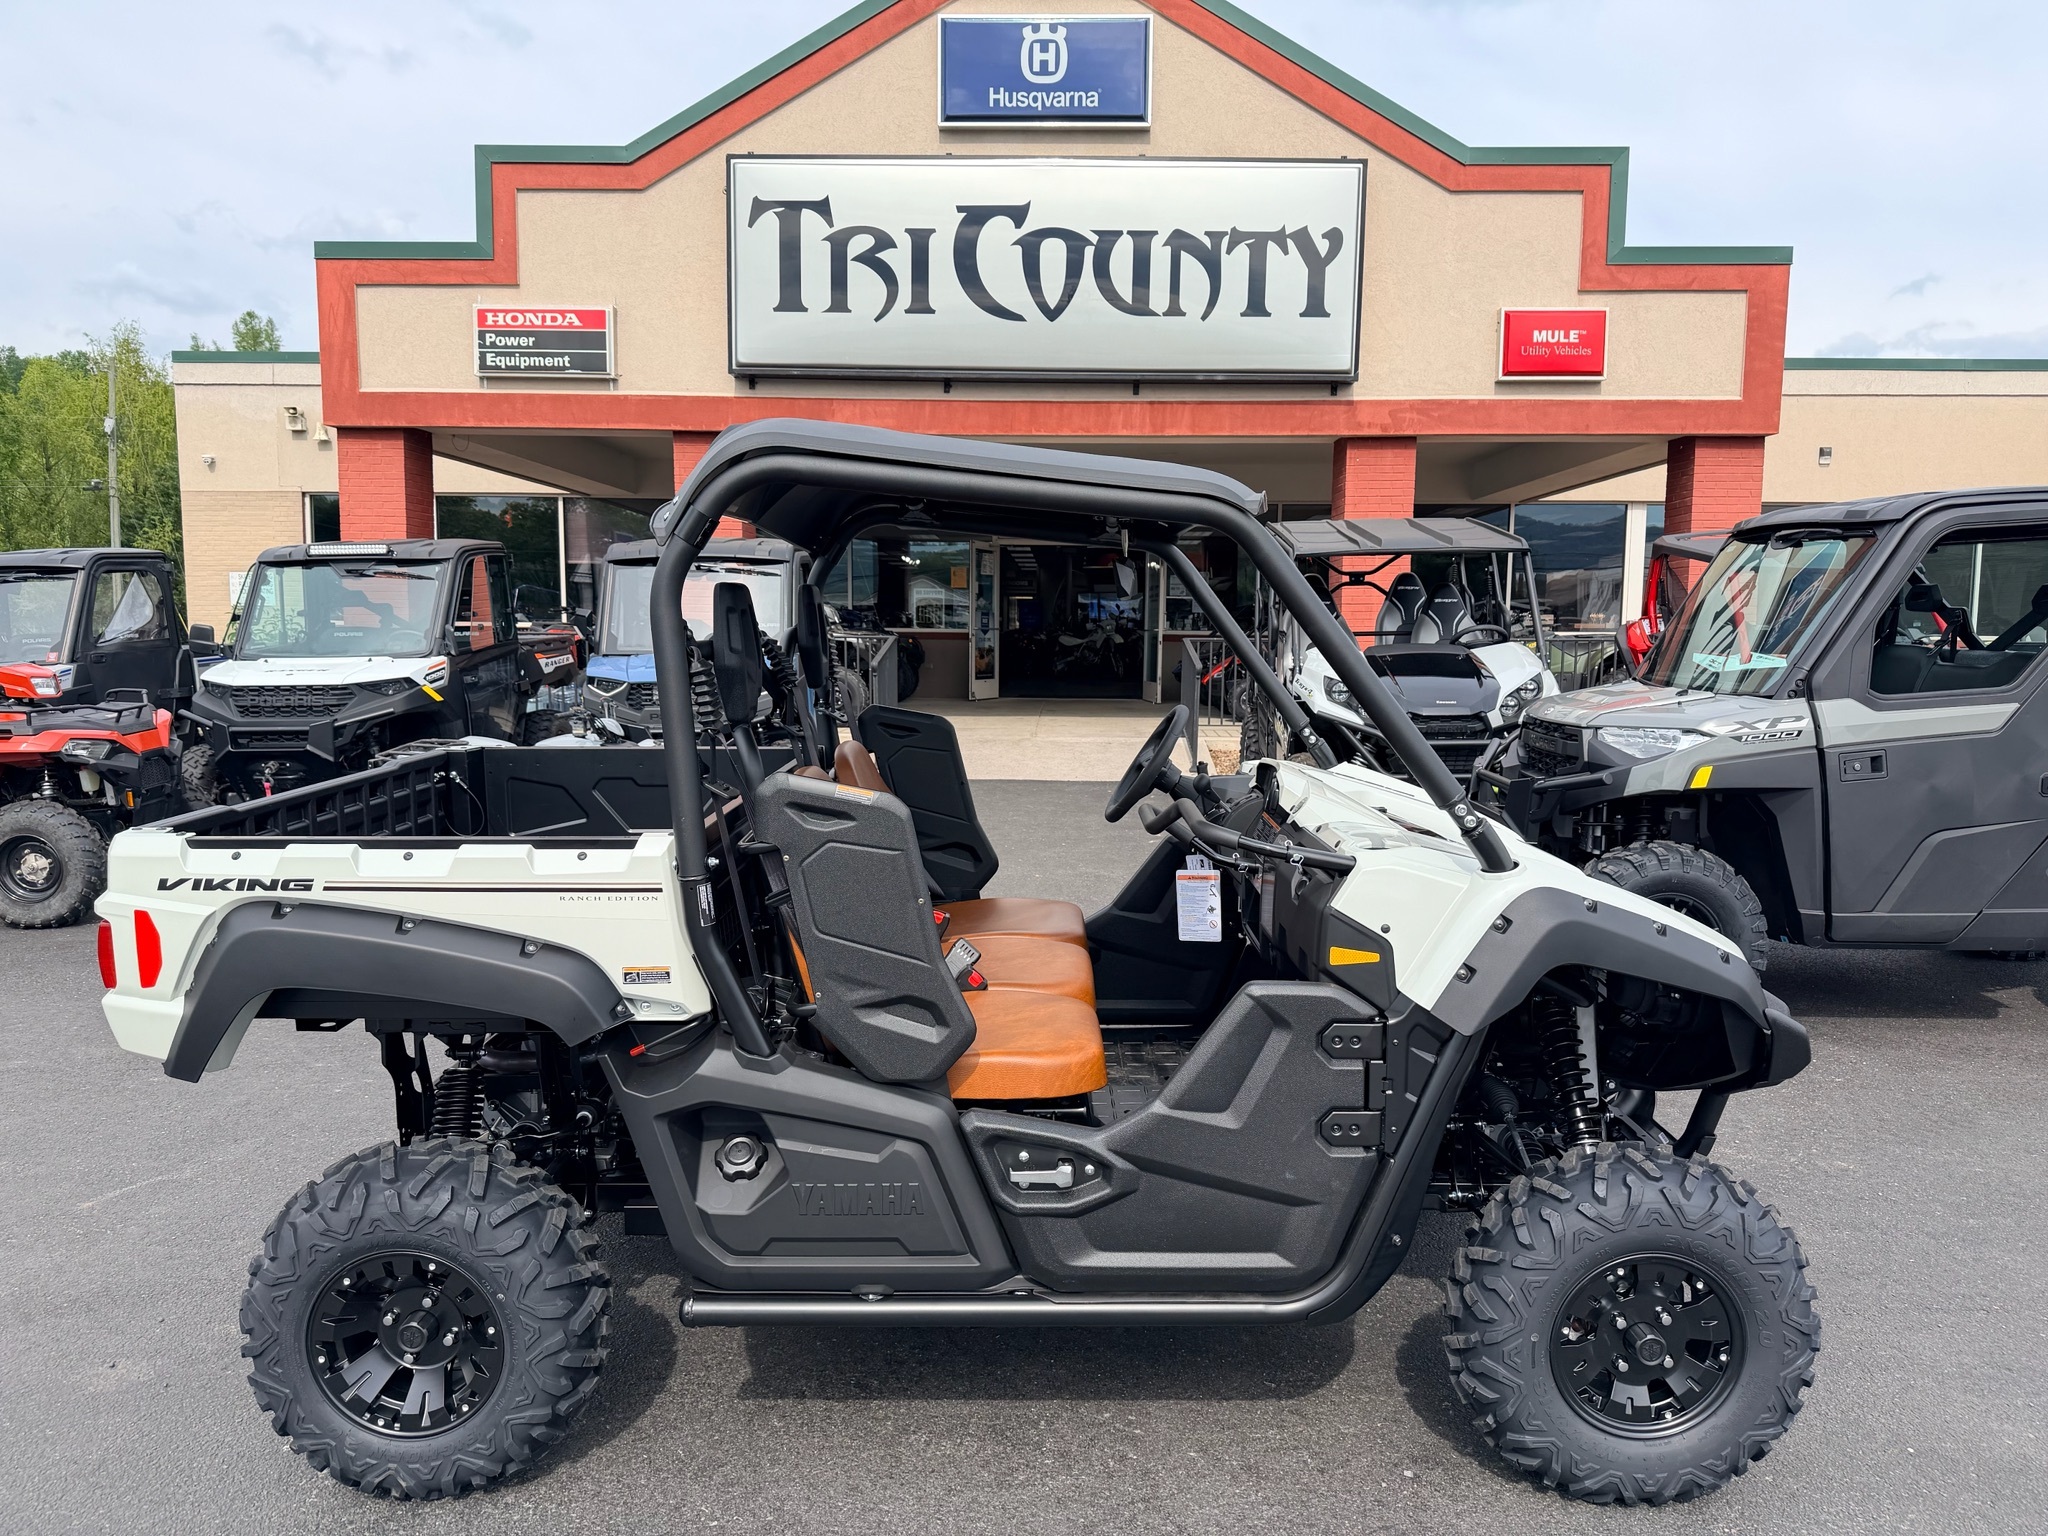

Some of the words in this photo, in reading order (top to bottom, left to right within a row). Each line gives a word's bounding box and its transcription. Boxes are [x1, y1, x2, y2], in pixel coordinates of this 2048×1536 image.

[989, 87, 1099, 111] Husqvarna
[485, 312, 583, 326] HONDA
[485, 333, 536, 347] Power
[1521, 346, 1552, 358] Utility
[1554, 345, 1592, 356] Vehicles
[485, 353, 571, 369] Equipment
[544, 655, 571, 669] RANGER
[425, 669, 446, 682] 1000
[247, 694, 326, 708] POLARIS
[1726, 715, 1808, 734] XP
[1740, 730, 1800, 743] 1000
[156, 877, 315, 893] VIKING
[791, 1182, 925, 1217] YAMAHA
